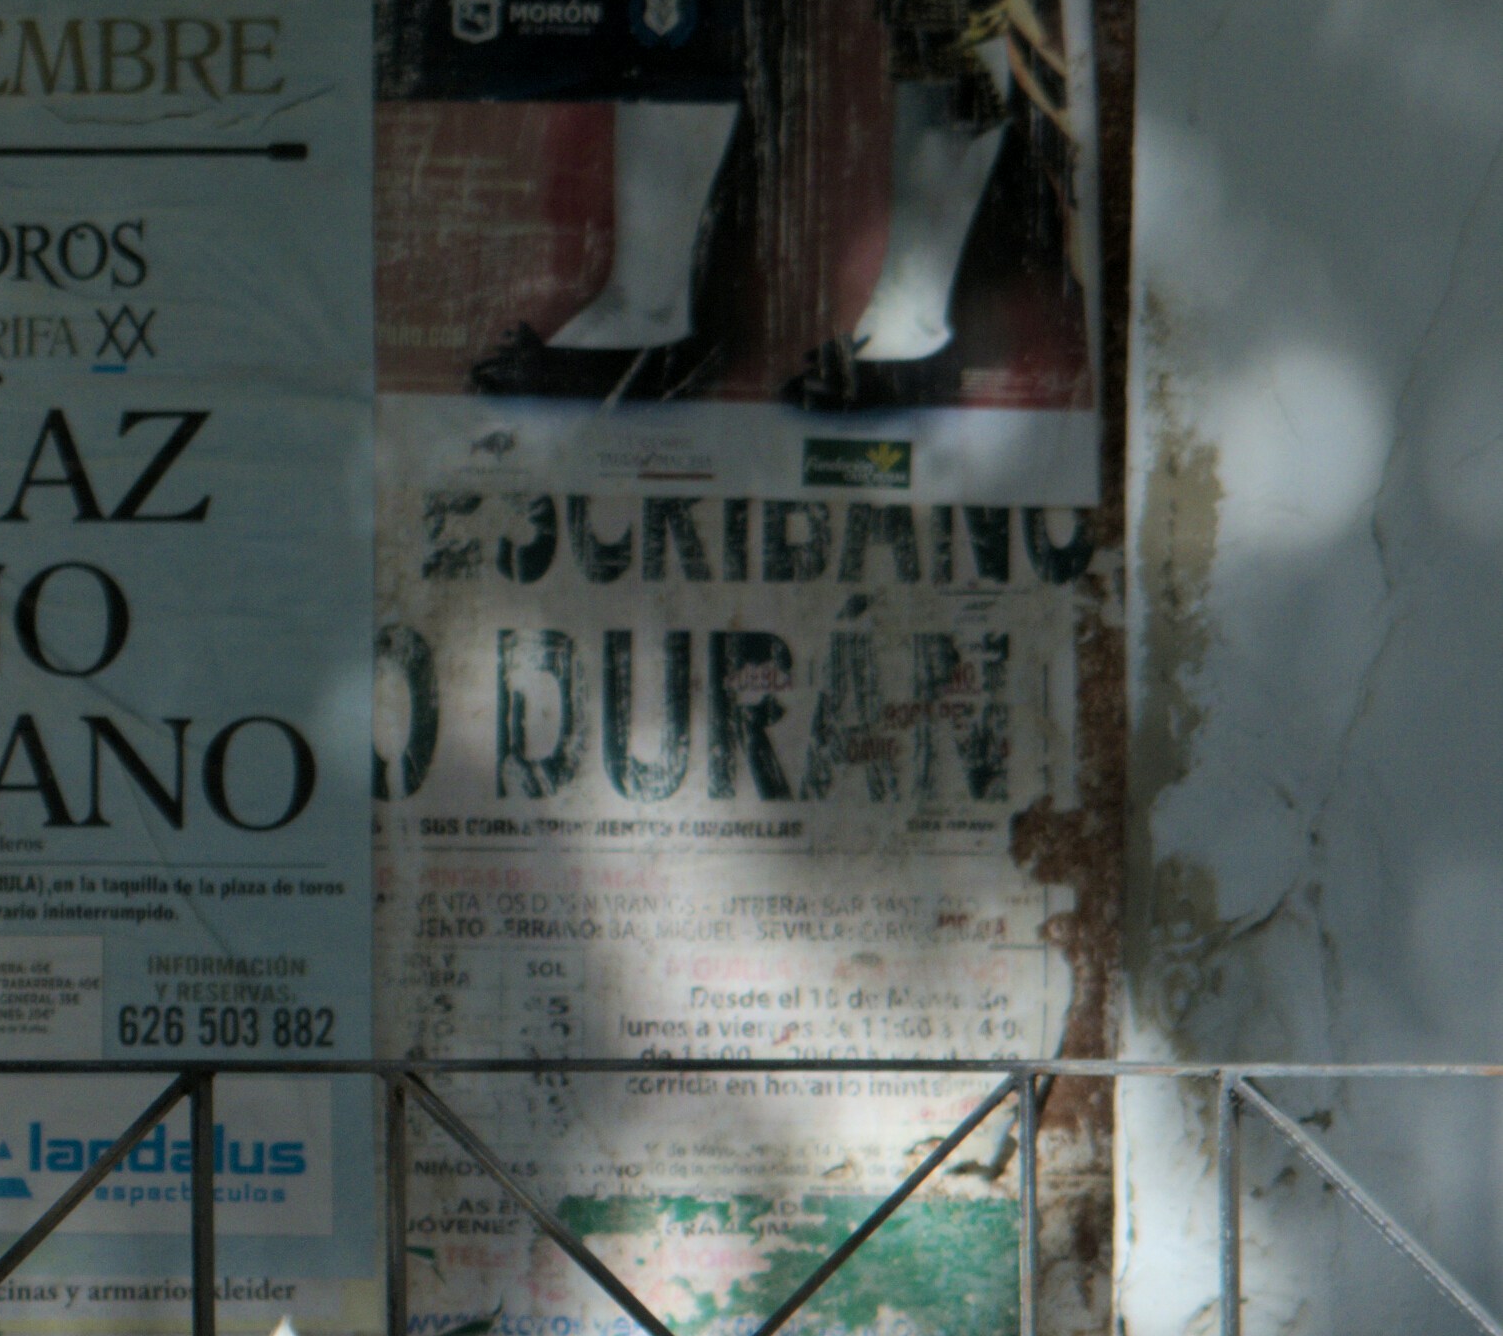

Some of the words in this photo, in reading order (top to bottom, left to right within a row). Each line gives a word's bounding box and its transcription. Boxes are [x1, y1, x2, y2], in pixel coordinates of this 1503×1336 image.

[44, 902, 179, 926] ininterrumpido.
[146, 950, 307, 980] INFORMACIÓN
[118, 1005, 185, 1047] 626
[198, 1006, 261, 1047] 503
[273, 1007, 336, 1048] 882
[95, 1182, 286, 1207] espectculos
